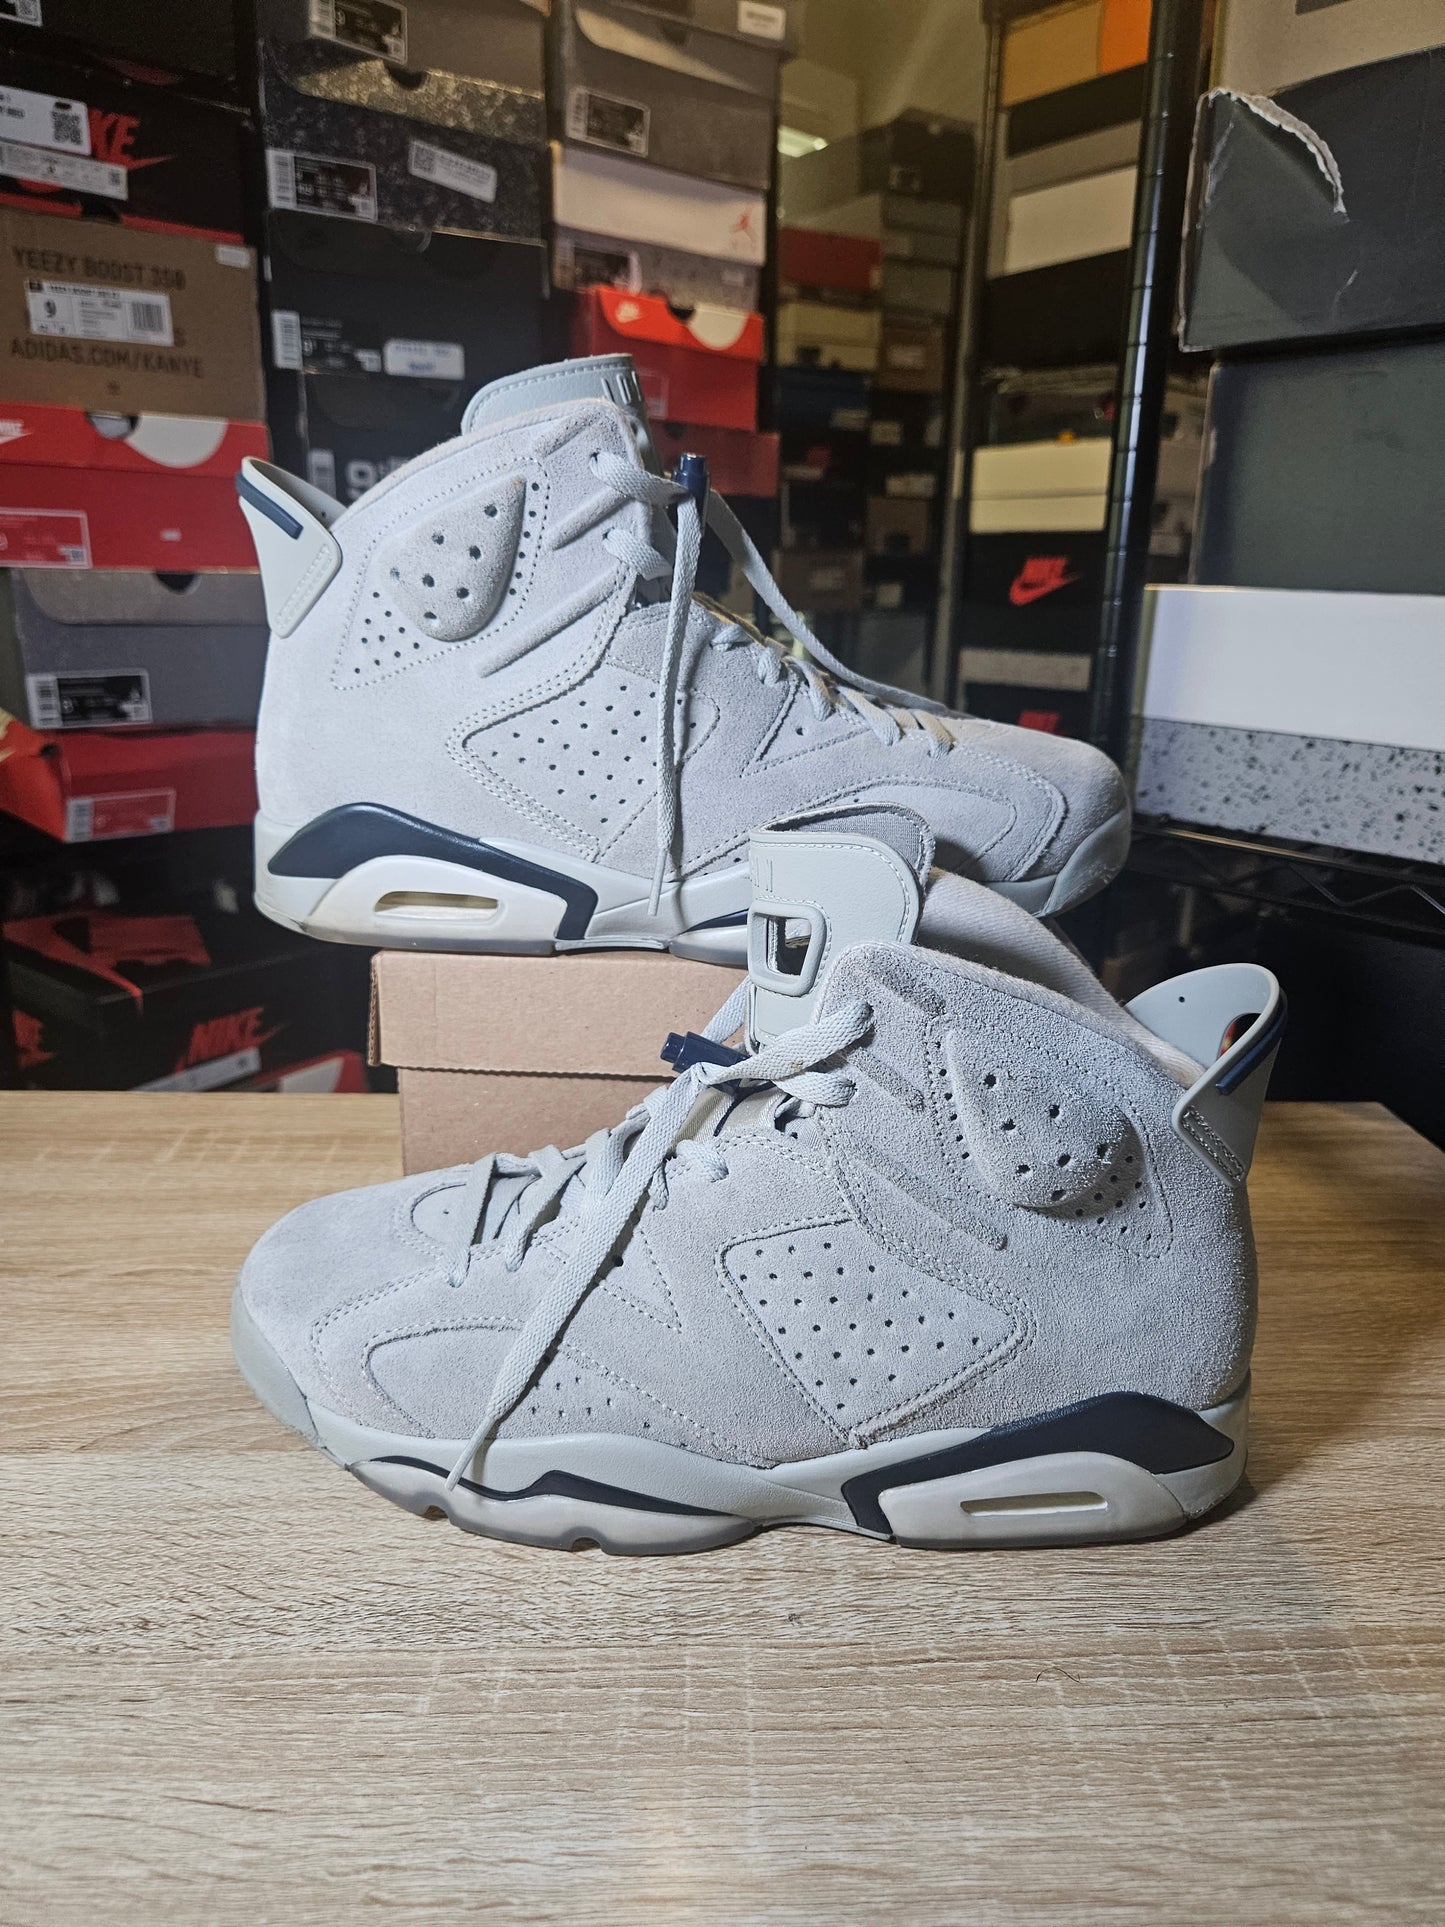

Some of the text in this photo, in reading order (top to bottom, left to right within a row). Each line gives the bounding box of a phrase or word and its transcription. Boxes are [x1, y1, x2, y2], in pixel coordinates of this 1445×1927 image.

[12, 246, 187, 291] YEEZY BOOST 350
[11, 336, 204, 379] ADIDAS.COM/KANYE
